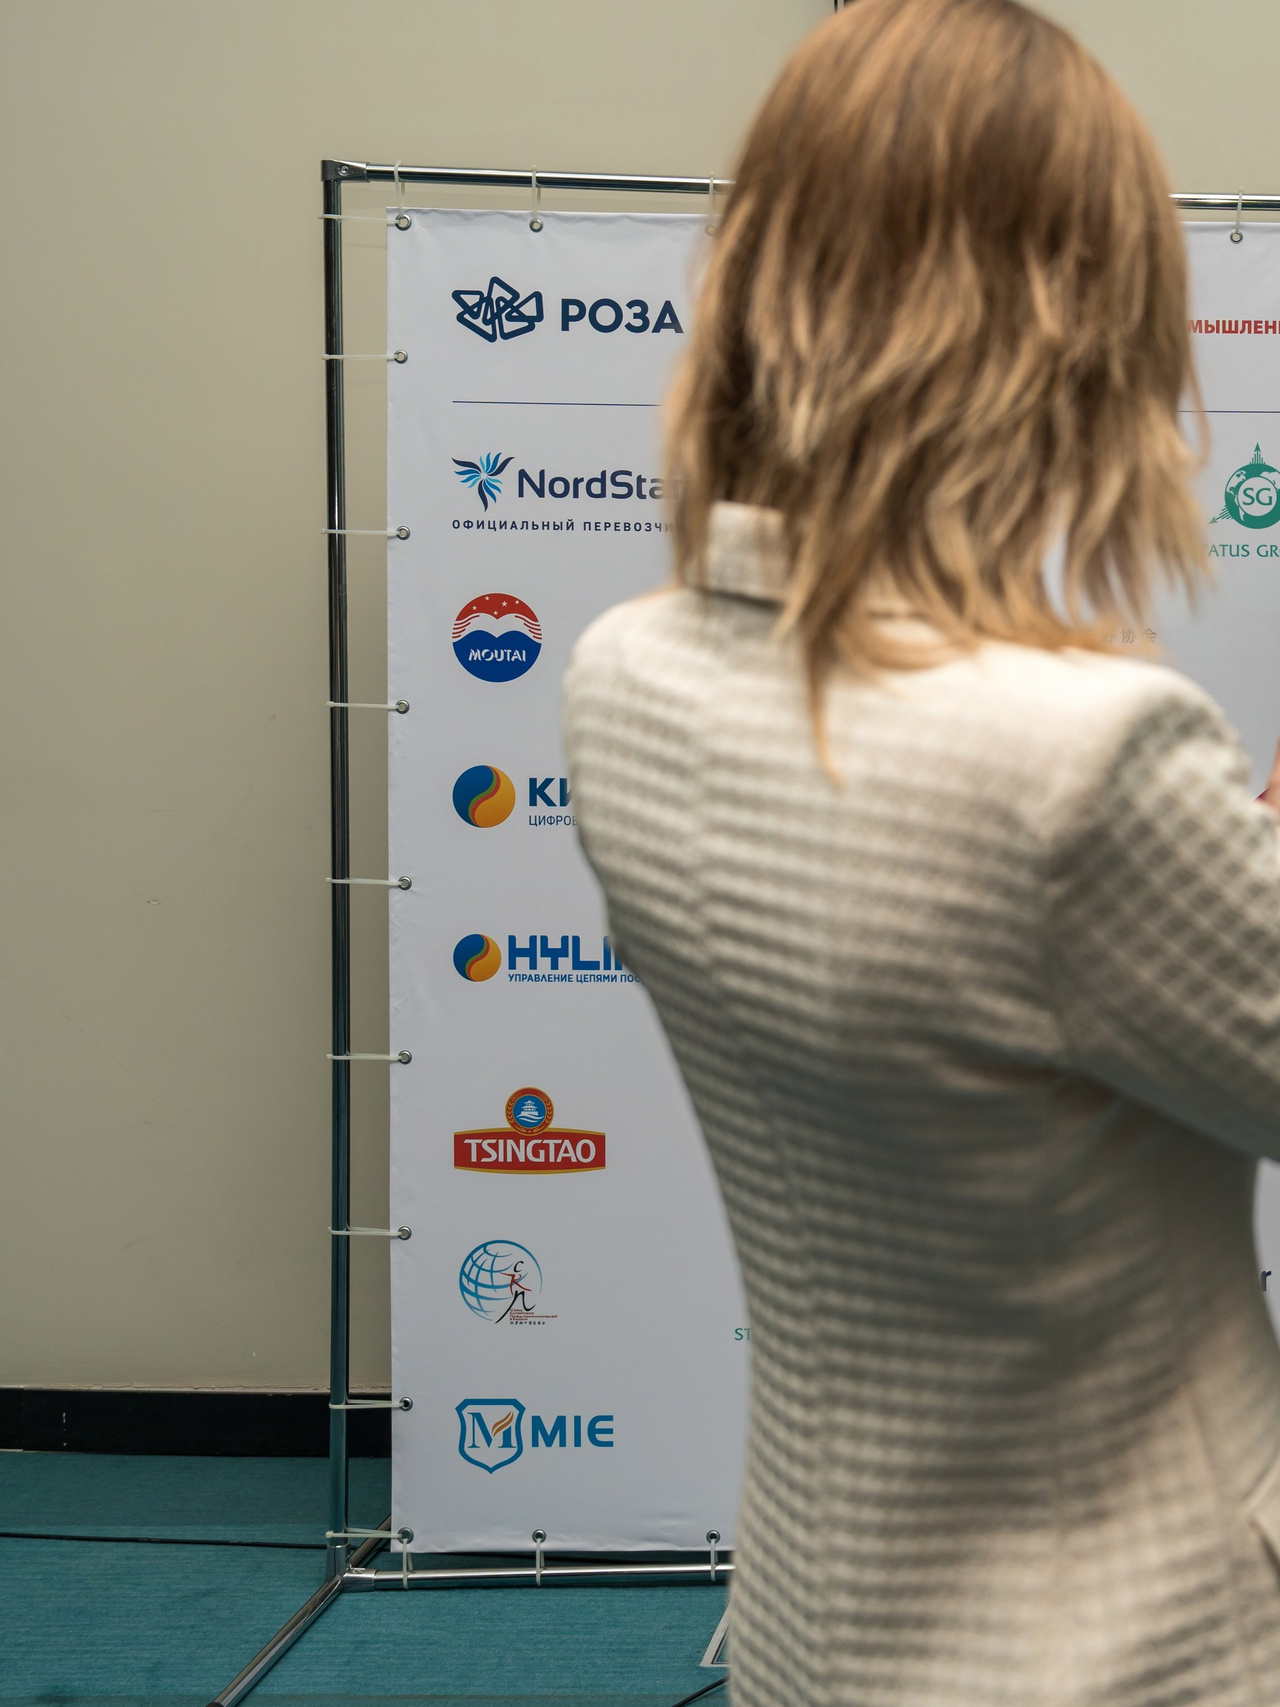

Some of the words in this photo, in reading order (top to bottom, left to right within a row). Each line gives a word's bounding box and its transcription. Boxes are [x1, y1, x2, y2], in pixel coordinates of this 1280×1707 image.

[560, 298, 684, 334] РОЗА
[1242, 487, 1273, 506] SG
[452, 519, 575, 532] ОФИЦИАЛЬНЫЙ
[1206, 544, 1250, 558] ATUS
[468, 648, 527, 663] MOUTAI
[508, 935, 623, 970] HYLI
[508, 973, 573, 983] УПРАВЛЕНИЕ
[576, 973, 617, 984] ЦЕПЯМИ
[463, 1138, 596, 1163] TSINGTAO
[531, 1414, 614, 1448] MIE
